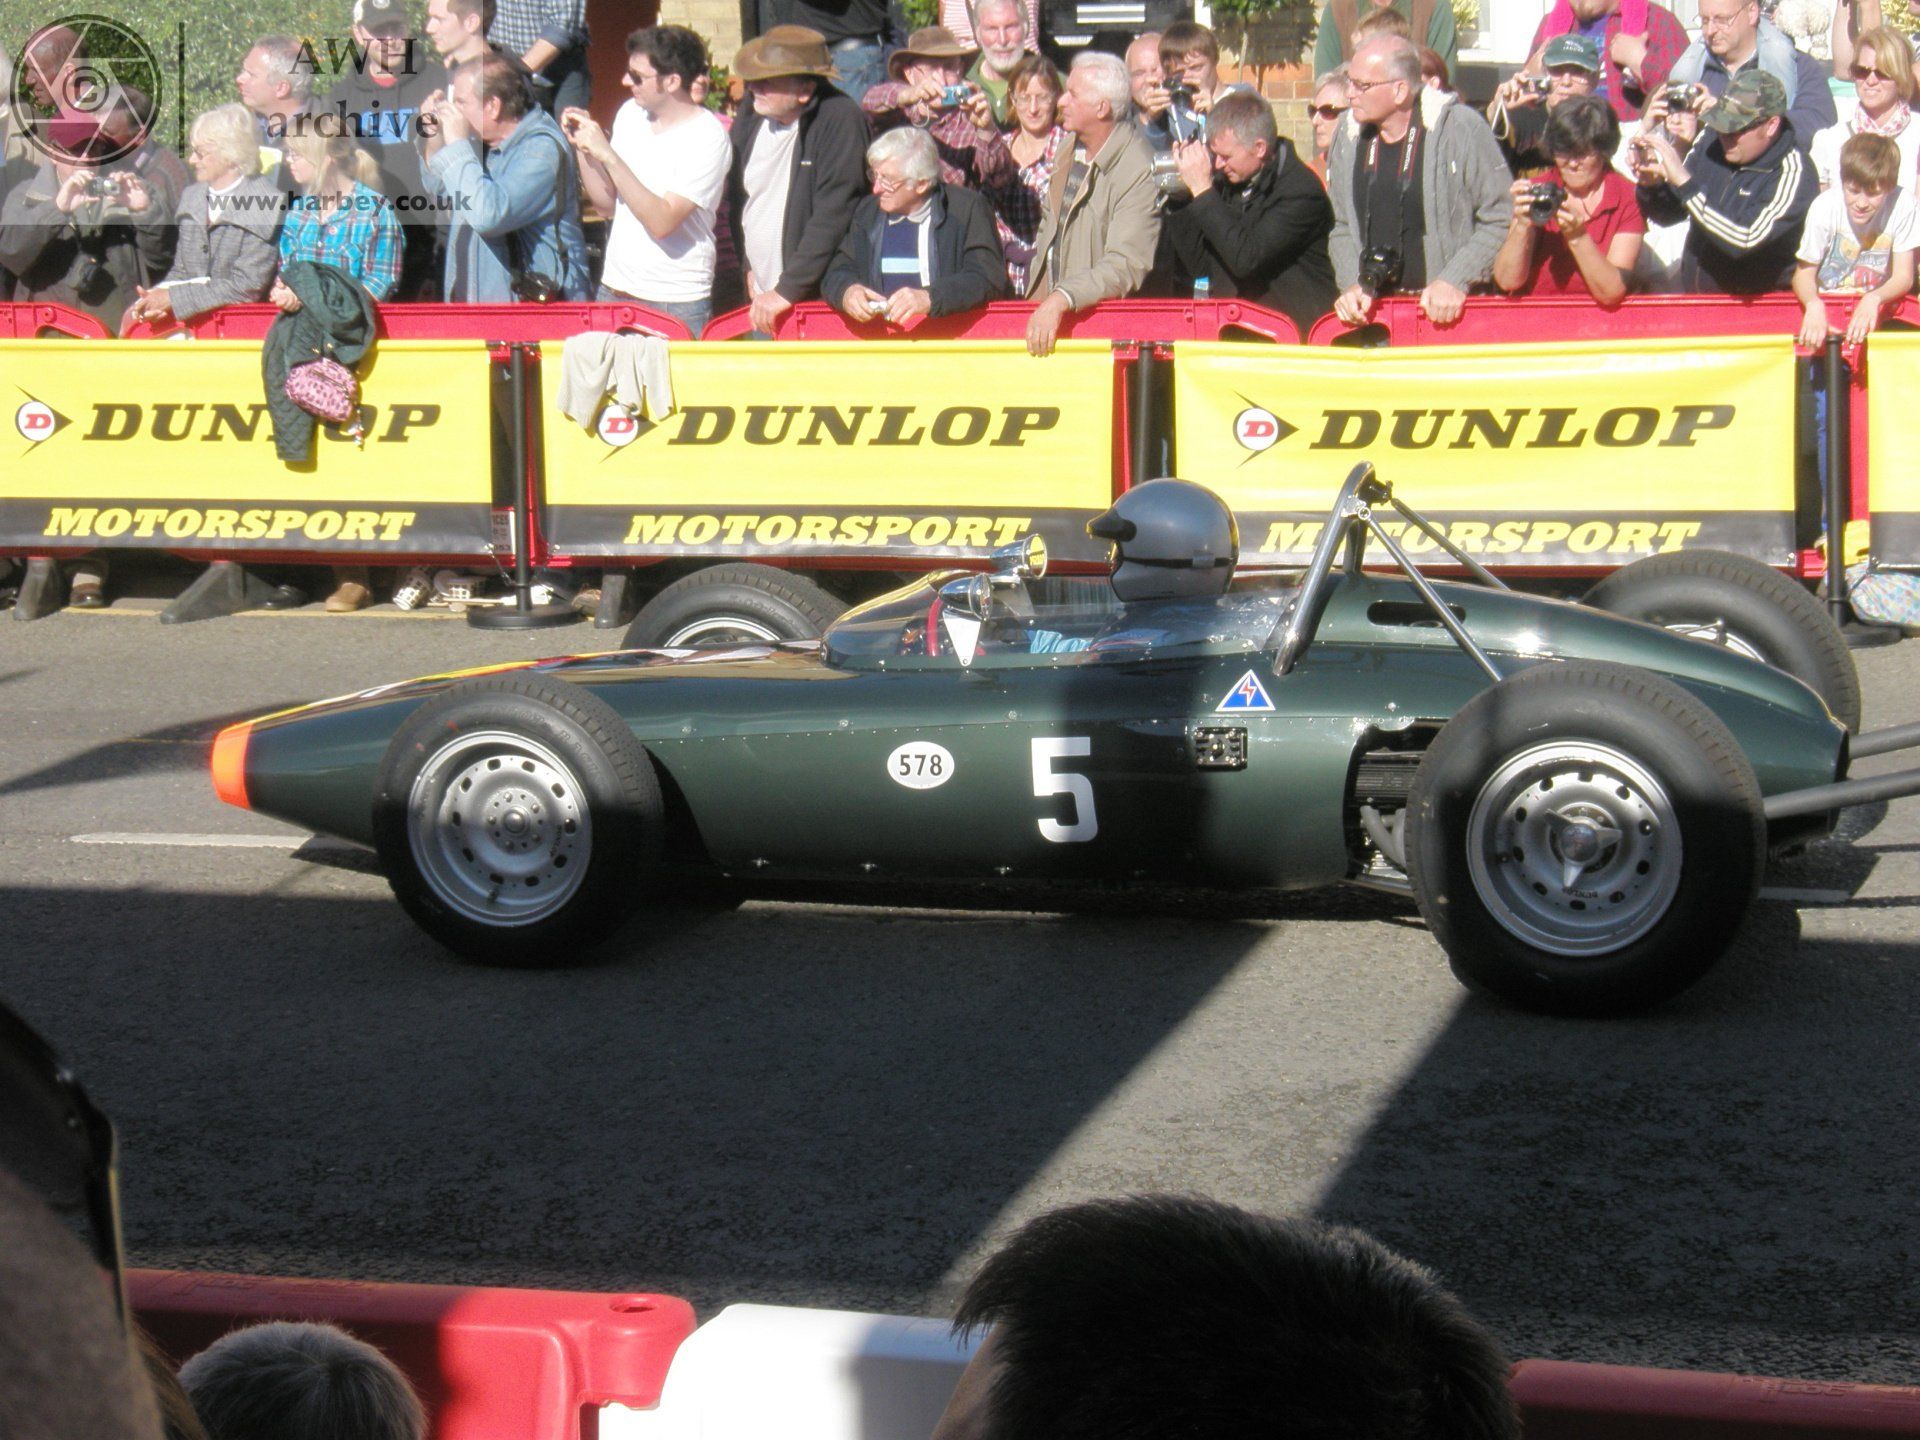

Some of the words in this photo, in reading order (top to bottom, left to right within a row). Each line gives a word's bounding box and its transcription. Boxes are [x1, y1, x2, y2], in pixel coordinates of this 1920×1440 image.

[82, 403, 441, 442] DUNOP
[667, 405, 1061, 446] DUNLOP
[1309, 404, 1736, 450] DUNLOP
[44, 508, 415, 541] MOTORSPORT
[623, 514, 1032, 548] MOTORSPORT
[1259, 520, 1702, 554] MTORSPORT
[899, 753, 943, 777] 578
[1031, 736, 1099, 844] 5
